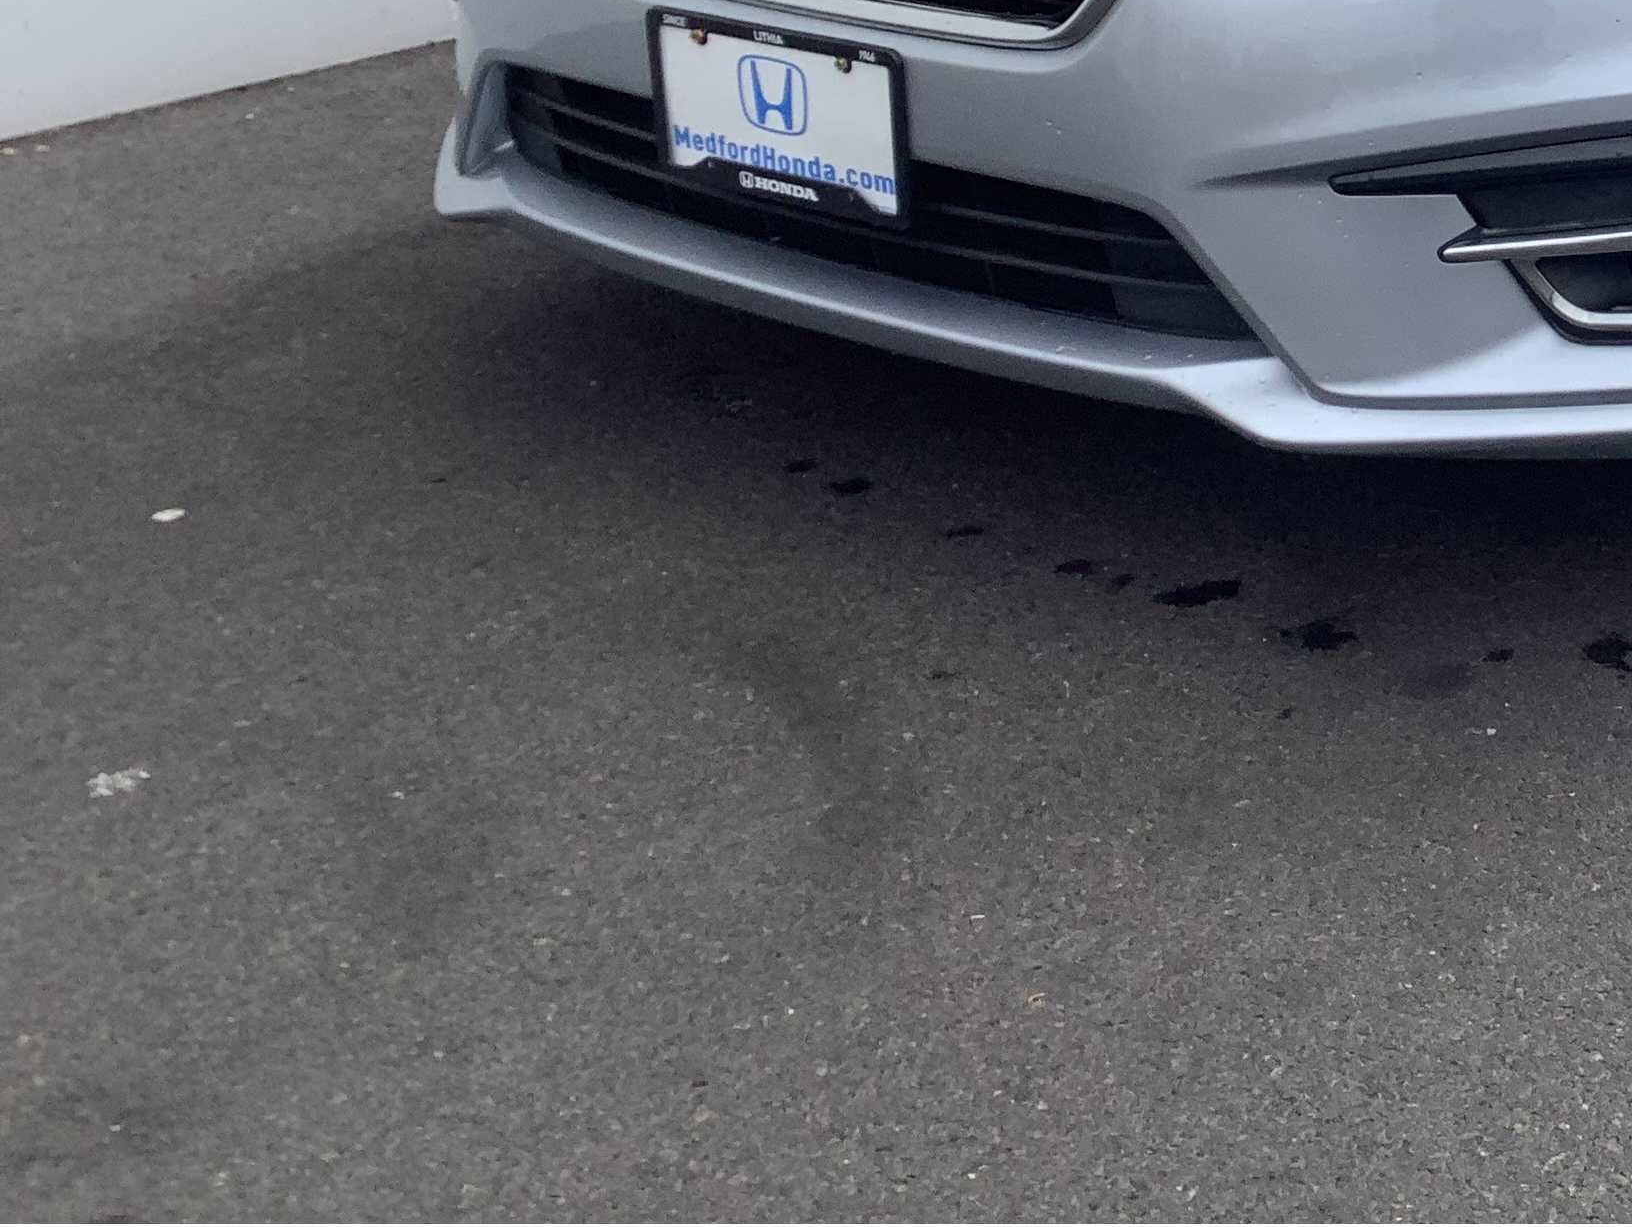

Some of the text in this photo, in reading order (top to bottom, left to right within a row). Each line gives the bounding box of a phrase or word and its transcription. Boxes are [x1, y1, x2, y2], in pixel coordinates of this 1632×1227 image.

[752, 30, 784, 45] LITHIA
[673, 125, 897, 195] MedfordHonda.com
[754, 175, 820, 202] HONDA
